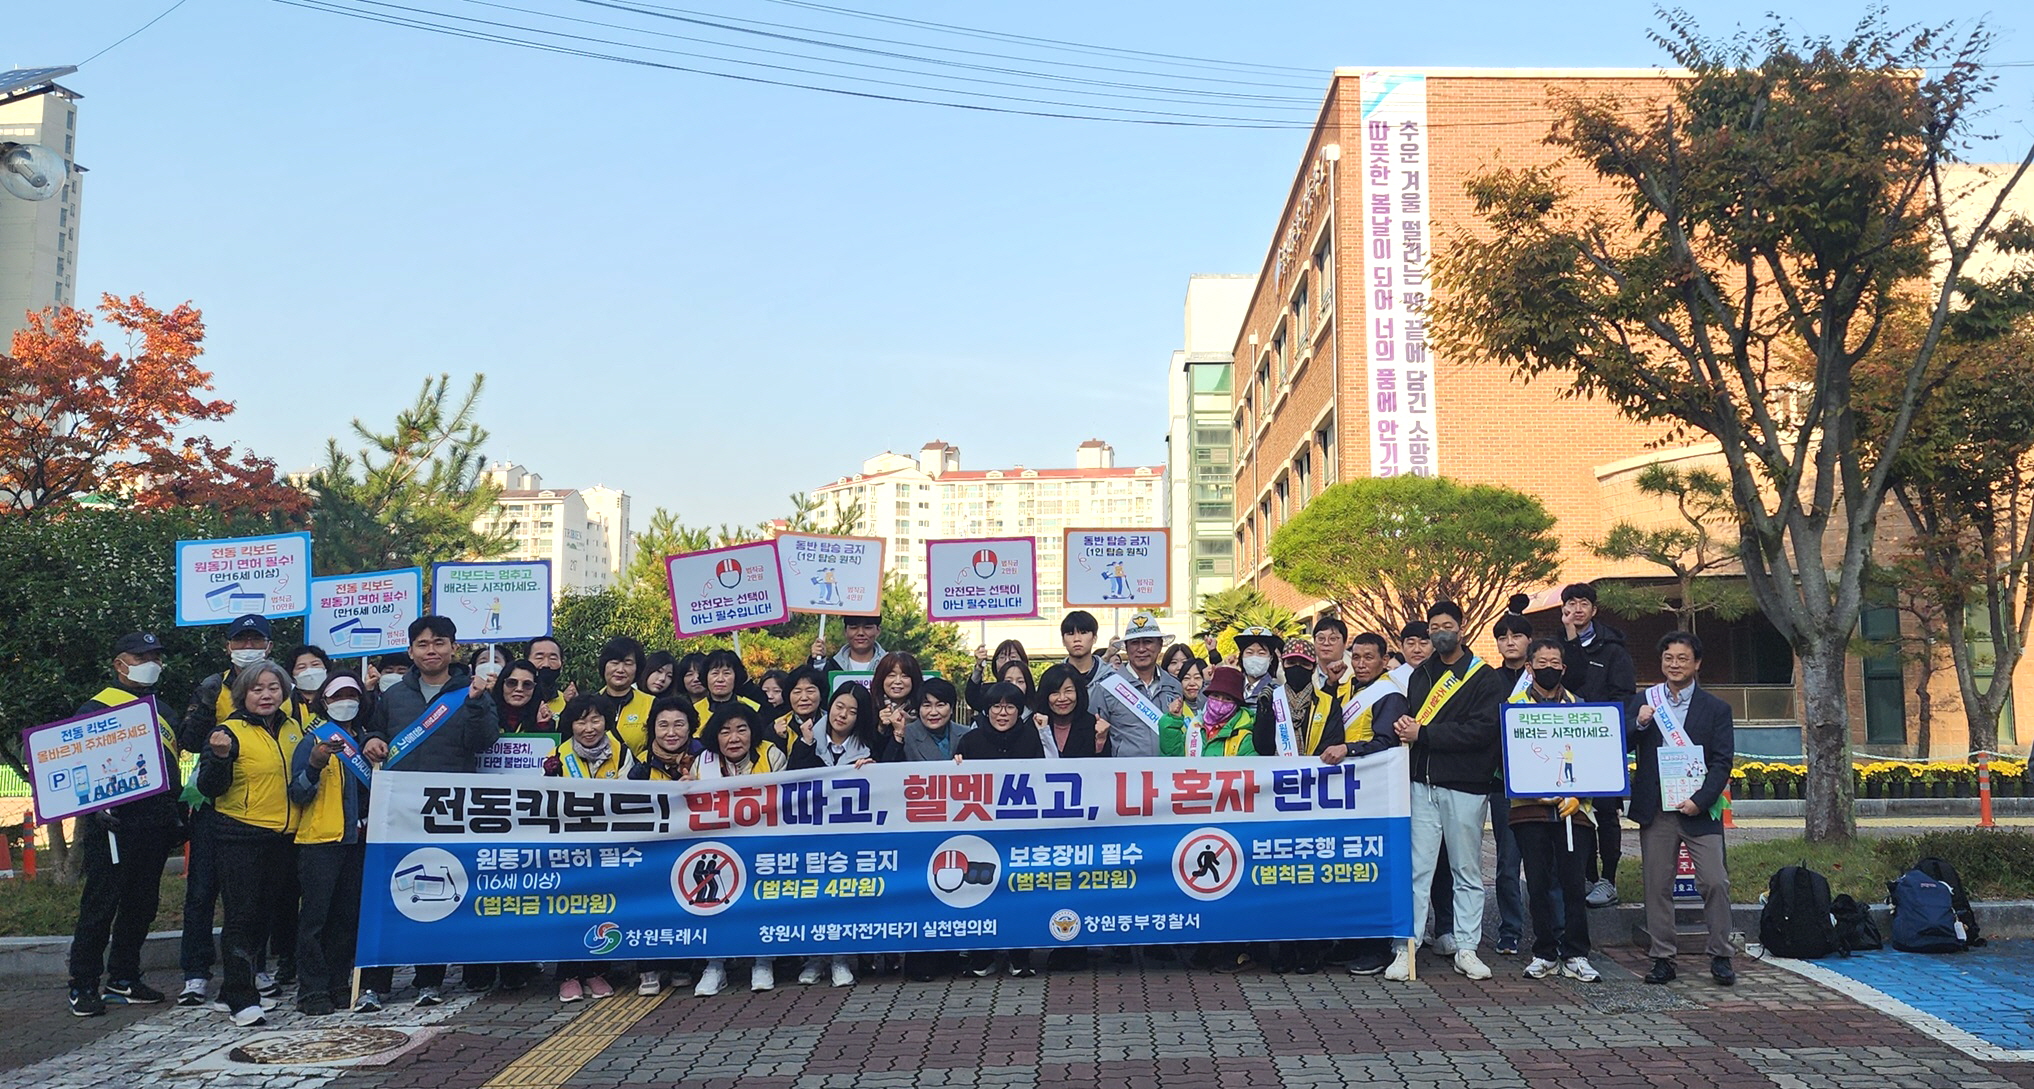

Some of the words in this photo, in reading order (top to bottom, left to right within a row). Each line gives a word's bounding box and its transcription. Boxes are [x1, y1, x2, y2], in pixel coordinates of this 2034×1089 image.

[1369, 120, 1391, 186] 따뜻한
[1399, 120, 1420, 164] 추운
[1401, 170, 1421, 213] 겨울
[1371, 193, 1393, 259] 봄날이
[1374, 267, 1393, 311] 되어
[1375, 317, 1395, 361] 너의
[1404, 319, 1425, 363] 끝에
[1376, 368, 1397, 413] 품에
[1406, 370, 1428, 414] 담긴
[211, 547, 237, 559] 전동
[241, 544, 278, 555] 킥보드
[796, 540, 817, 551] 동반
[820, 542, 841, 553] 탑승
[844, 544, 865, 554] 금지
[1084, 536, 1104, 546] 동반
[1107, 536, 1127, 546] 탑승
[1130, 536, 1150, 546] 금지
[1086, 547, 1103, 557] (1인
[1106, 547, 1123, 557] 탑승
[1127, 547, 1148, 557] 원칙)
[194, 560, 233, 573] 원동기
[237, 558, 261, 570] 면허
[266, 555, 294, 567] 필수!
[797, 551, 816, 562] (1인
[818, 554, 836, 563] 탑승
[839, 555, 862, 565] 원칙)
[210, 571, 250, 583] (만16세
[253, 568, 280, 579] 이상)
[450, 570, 495, 581] 킥보드는
[498, 569, 532, 580] 멈추고
[335, 583, 357, 594] 전동
[361, 579, 393, 591] 킥보드
[444, 583, 478, 593] 배려는
[481, 581, 540, 592] 시작하세요.
[944, 586, 985, 597] 안전모는
[989, 584, 1020, 596] 선택이
[321, 595, 354, 608] 원동기
[357, 593, 379, 605] 면허
[382, 590, 407, 603] 필수!
[372, 603, 394, 614] 이상)
[690, 597, 733, 612] 안전모는
[736, 590, 768, 605] 선택이
[943, 599, 963, 610] 아닌
[967, 597, 1022, 609] 필수입니다!
[691, 612, 713, 625] 아닌
[715, 603, 772, 621] 필수입니다!
[61, 726, 83, 743] 전동
[86, 716, 122, 733] 킥보드,
[1519, 713, 1564, 725] 킥보드는
[1568, 712, 1603, 724] 멈추고
[37, 742, 82, 764] 올바르게
[85, 723, 151, 750] 주차해주세요.
[1514, 727, 1548, 739] 배려는
[1551, 726, 1613, 738] 시작하세요.
[483, 757, 502, 769] 타면
[52, 773, 65, 788] P
[420, 787, 669, 835] 전동킥보드!
[683, 779, 888, 830] 면허따고,
[903, 771, 1099, 822] 헬멧쓰고,
[1114, 770, 1158, 816] 나
[1170, 769, 1260, 816] 혼자
[1272, 764, 1361, 812] 탄다
[475, 848, 542, 871] 원동기
[547, 848, 594, 869] 면허
[599, 846, 643, 868] 필수
[1009, 844, 1094, 867] 보호장비
[1101, 843, 1143, 864] 필수
[1251, 838, 1337, 860] 보도주행
[1342, 836, 1384, 857] 금지
[754, 851, 799, 874] 동반
[805, 850, 848, 873] 탑승
[855, 849, 898, 872] 금지
[476, 872, 519, 892] (16세
[523, 871, 561, 890] 이상)
[1009, 870, 1073, 892] (범칙금
[1078, 869, 1137, 890] 2만원)
[1251, 864, 1316, 886] (범칙금
[1321, 862, 1379, 884] 3만원)
[754, 877, 820, 900] (범칙금
[824, 876, 885, 898] 4만원)
[474, 895, 541, 917] (범칙금
[546, 893, 616, 916] 10만원)
[759, 924, 806, 943] 창원시
[810, 922, 918, 941] 생활자전거타기
[922, 918, 998, 937] 실천협의회
[1084, 913, 1200, 933] 창원중부경찰서
[625, 927, 708, 946] 창원특례시
